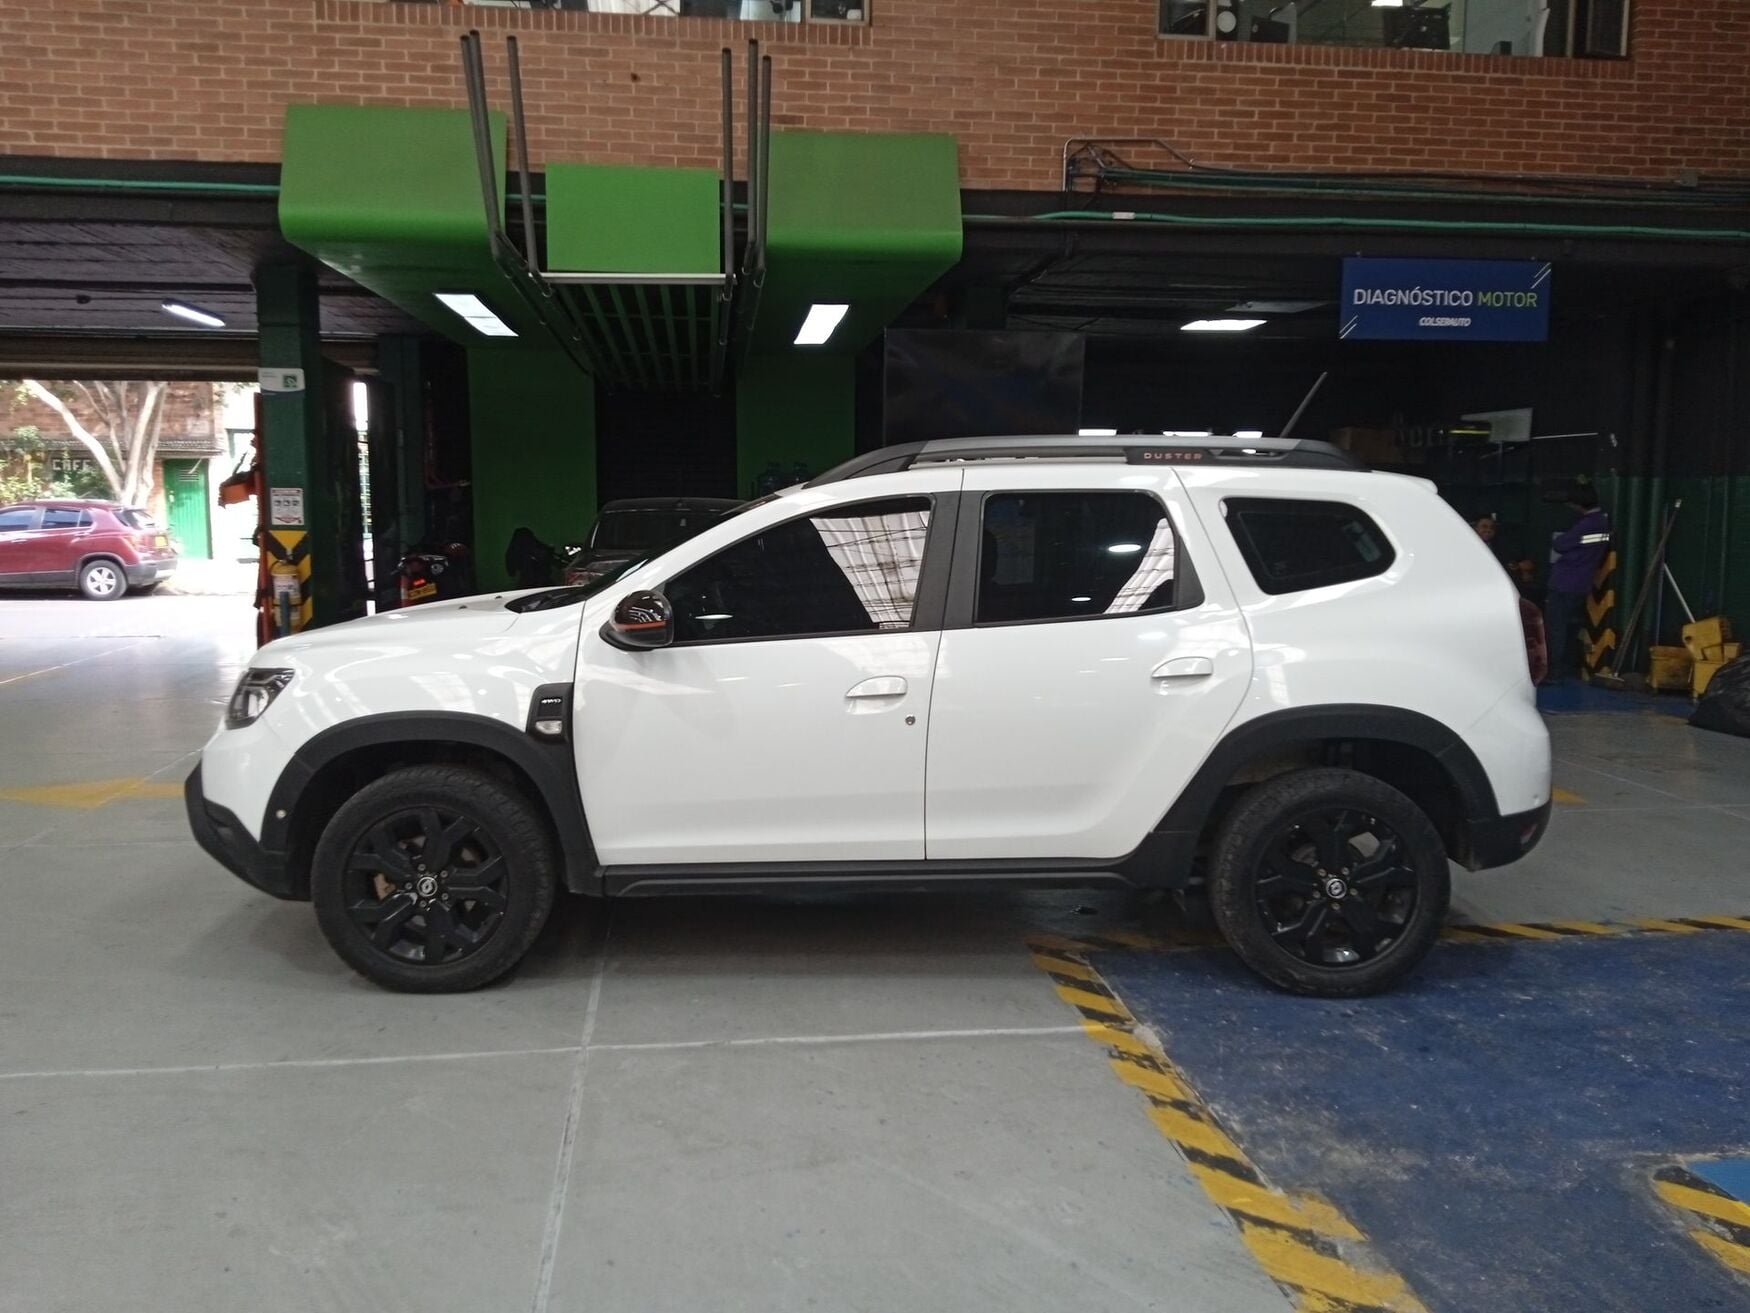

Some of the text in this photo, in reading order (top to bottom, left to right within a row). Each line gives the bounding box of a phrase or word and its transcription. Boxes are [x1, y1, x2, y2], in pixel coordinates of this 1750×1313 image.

[1353, 286, 1537, 307] DIAGNÓSTICO MOTOR
[1143, 452, 1203, 460] DUSTER
